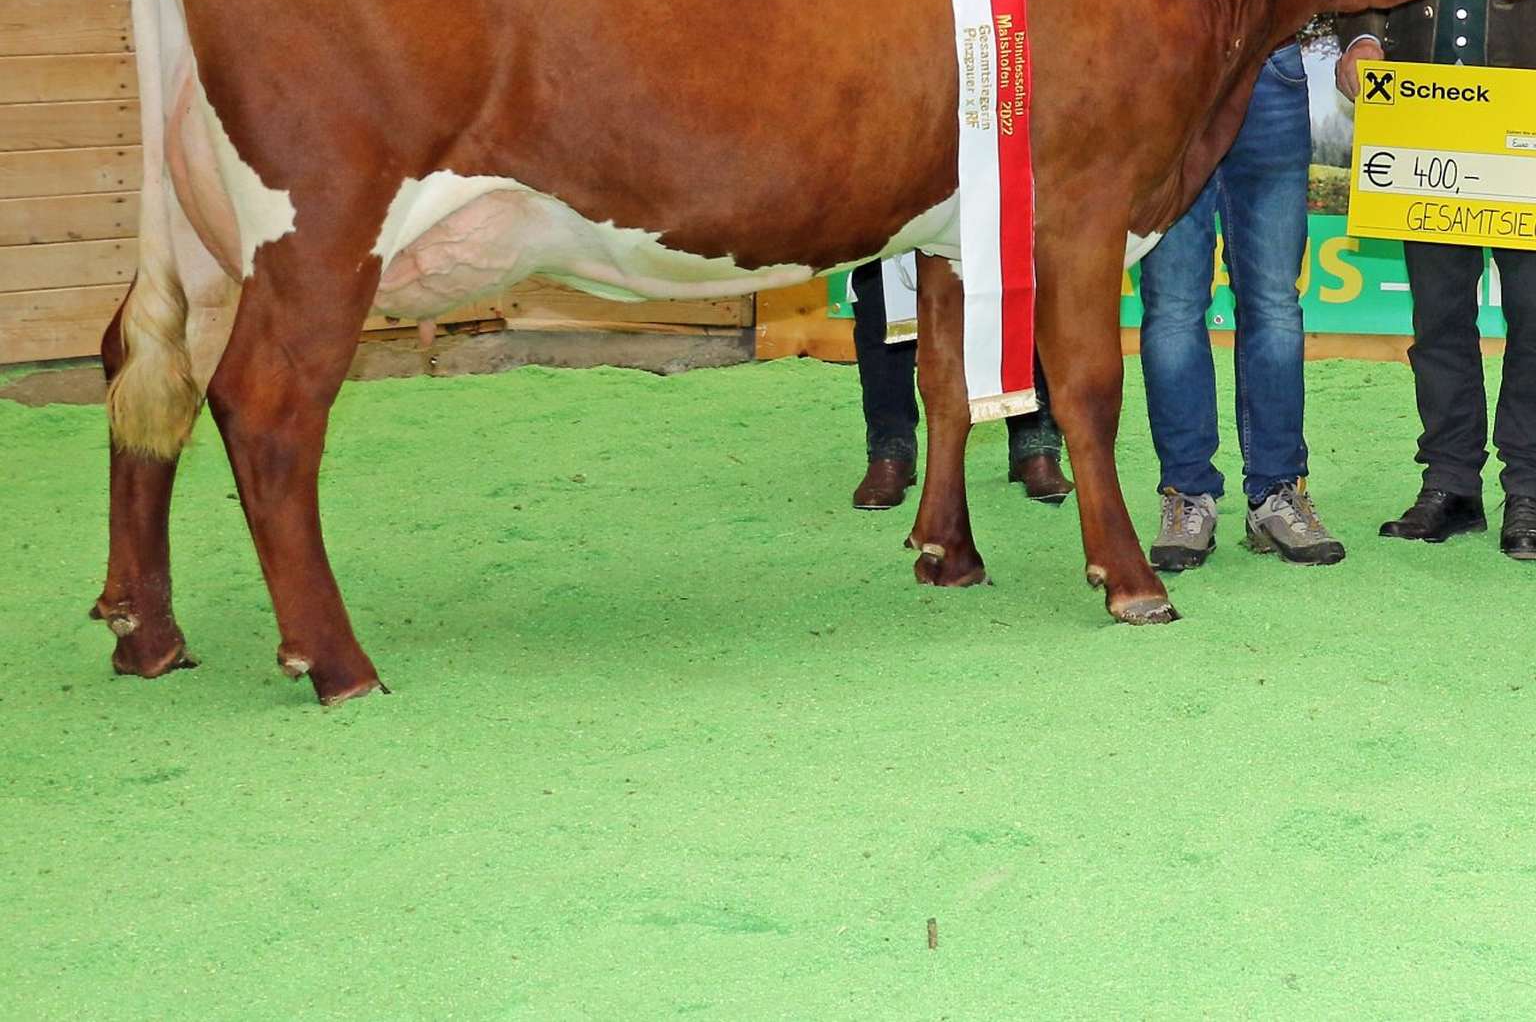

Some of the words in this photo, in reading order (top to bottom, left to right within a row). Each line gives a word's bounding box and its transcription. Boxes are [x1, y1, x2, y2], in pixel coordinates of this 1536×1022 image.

[962, 27, 978, 93] Pinzgauer
[978, 24, 992, 131] Gesamtsiegerin
[995, 14, 1014, 89] Maishofen
[1013, 31, 1026, 116] Bundesschau
[1000, 101, 1014, 136] 2022
[1399, 80, 1489, 103] Scheck
